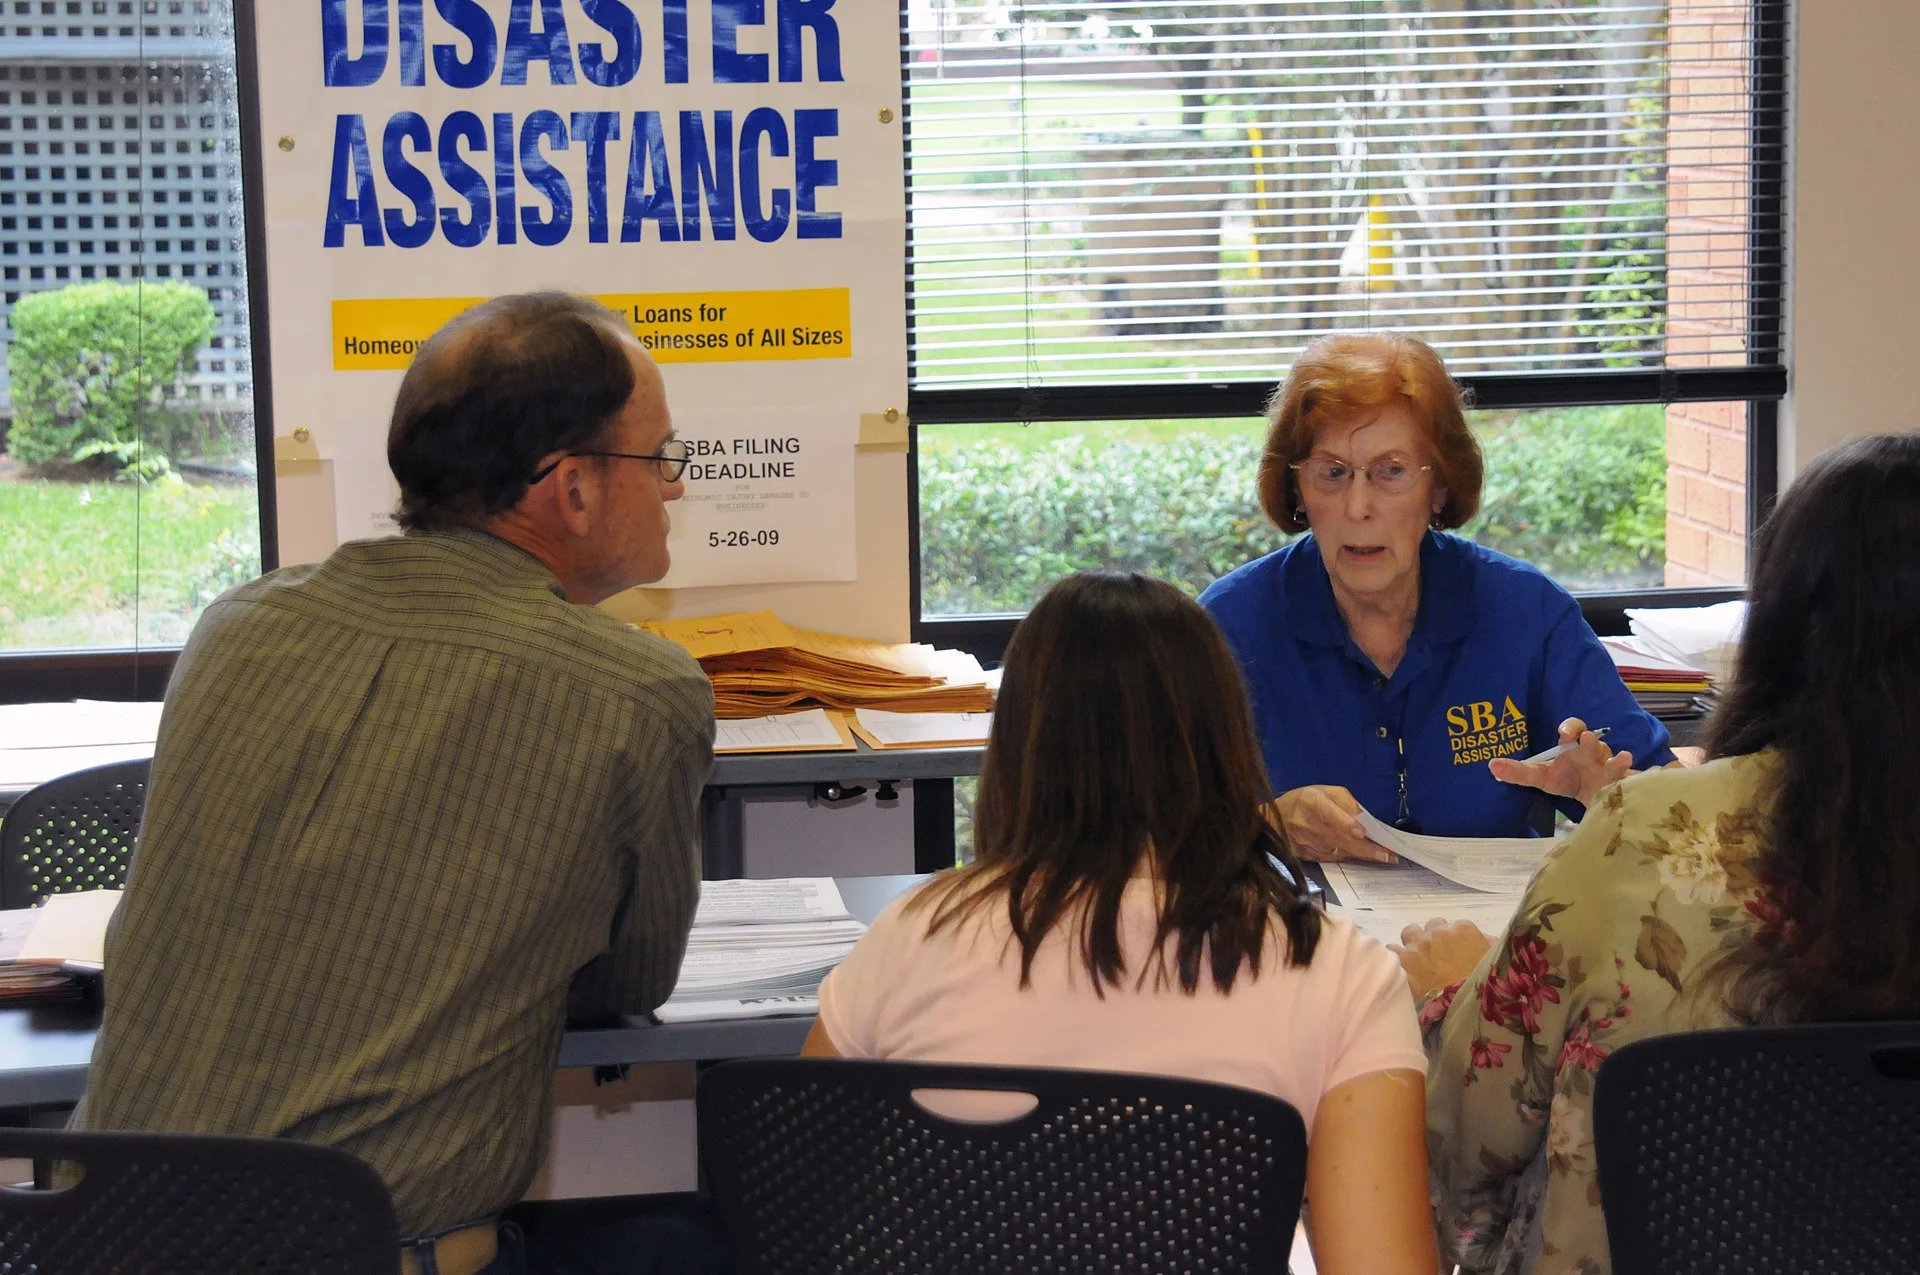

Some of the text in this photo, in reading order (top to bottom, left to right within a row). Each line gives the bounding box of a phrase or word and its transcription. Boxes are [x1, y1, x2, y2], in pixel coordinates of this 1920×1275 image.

[322, 0, 845, 89] DISASTER
[323, 107, 843, 248] ASSISTANCE
[633, 305, 692, 324] Loans
[699, 304, 727, 322] for
[735, 328, 754, 347] of
[761, 328, 785, 347] All
[792, 327, 843, 346] Sizes
[685, 437, 800, 457] SBA FILING
[690, 462, 795, 480] DEADLINE
[709, 529, 780, 547] 5-26-09
[1446, 695, 1525, 736] SBA
[1451, 721, 1528, 751] DISASTER
[1454, 735, 1529, 765] ASSISTANCE
